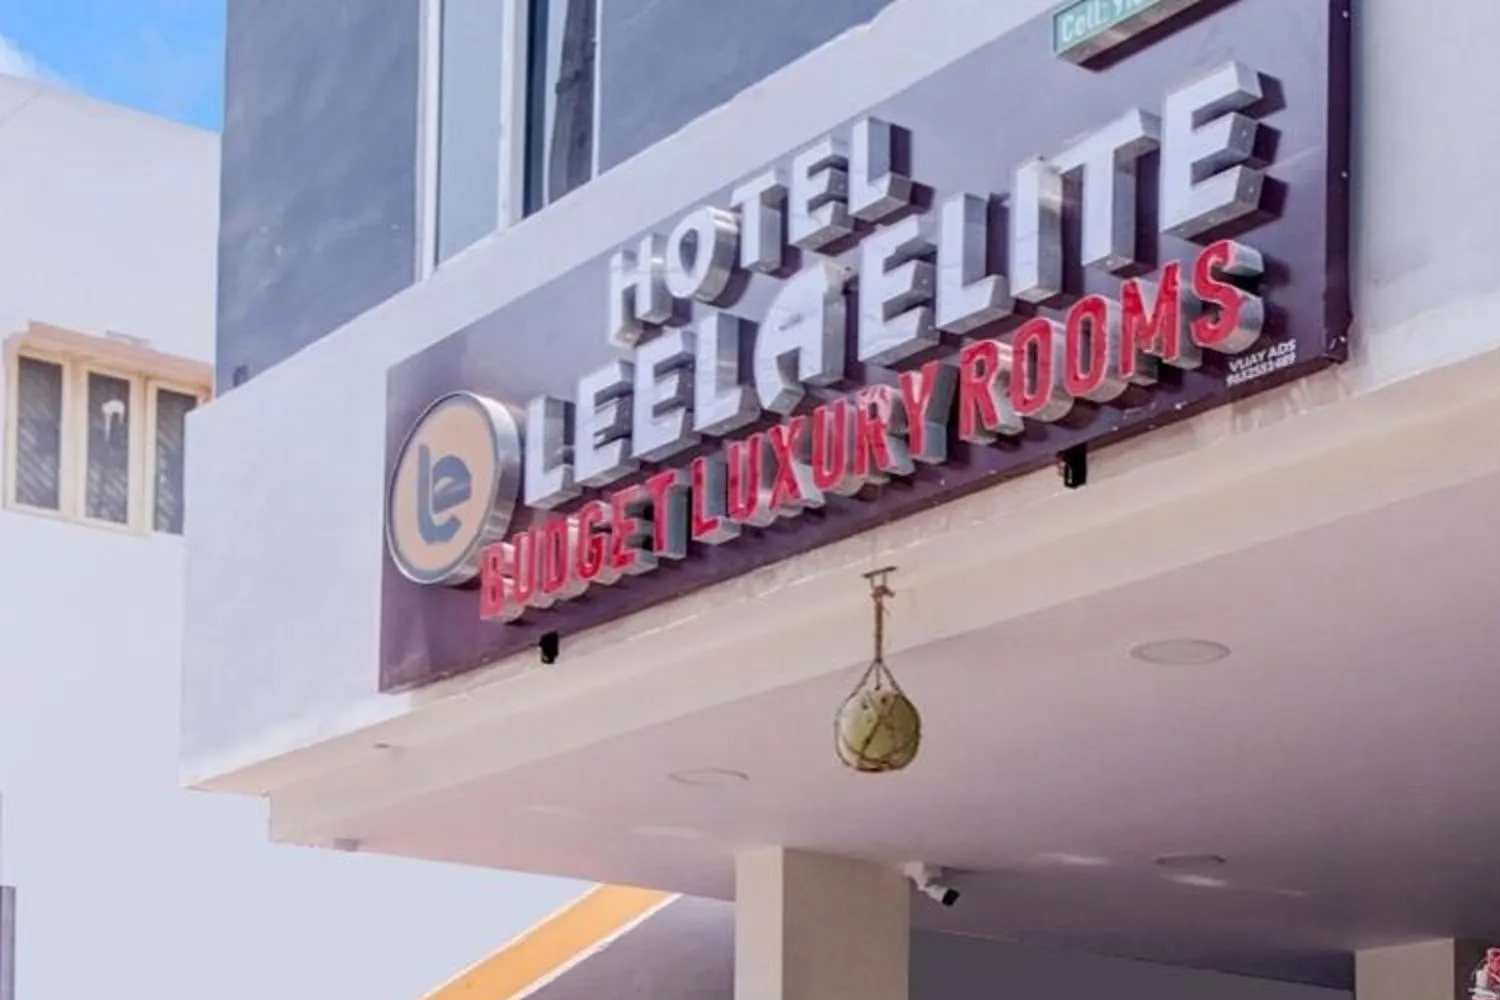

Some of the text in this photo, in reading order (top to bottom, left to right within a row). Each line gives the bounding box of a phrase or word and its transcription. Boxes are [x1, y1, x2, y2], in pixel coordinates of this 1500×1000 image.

[524, 60, 1262, 507] LEELAELITE
[608, 116, 906, 348] HOTEL
[1228, 338, 1297, 373] VIJAY ADS
[480, 239, 1256, 622] BUDGET LUXURY ROOMS
